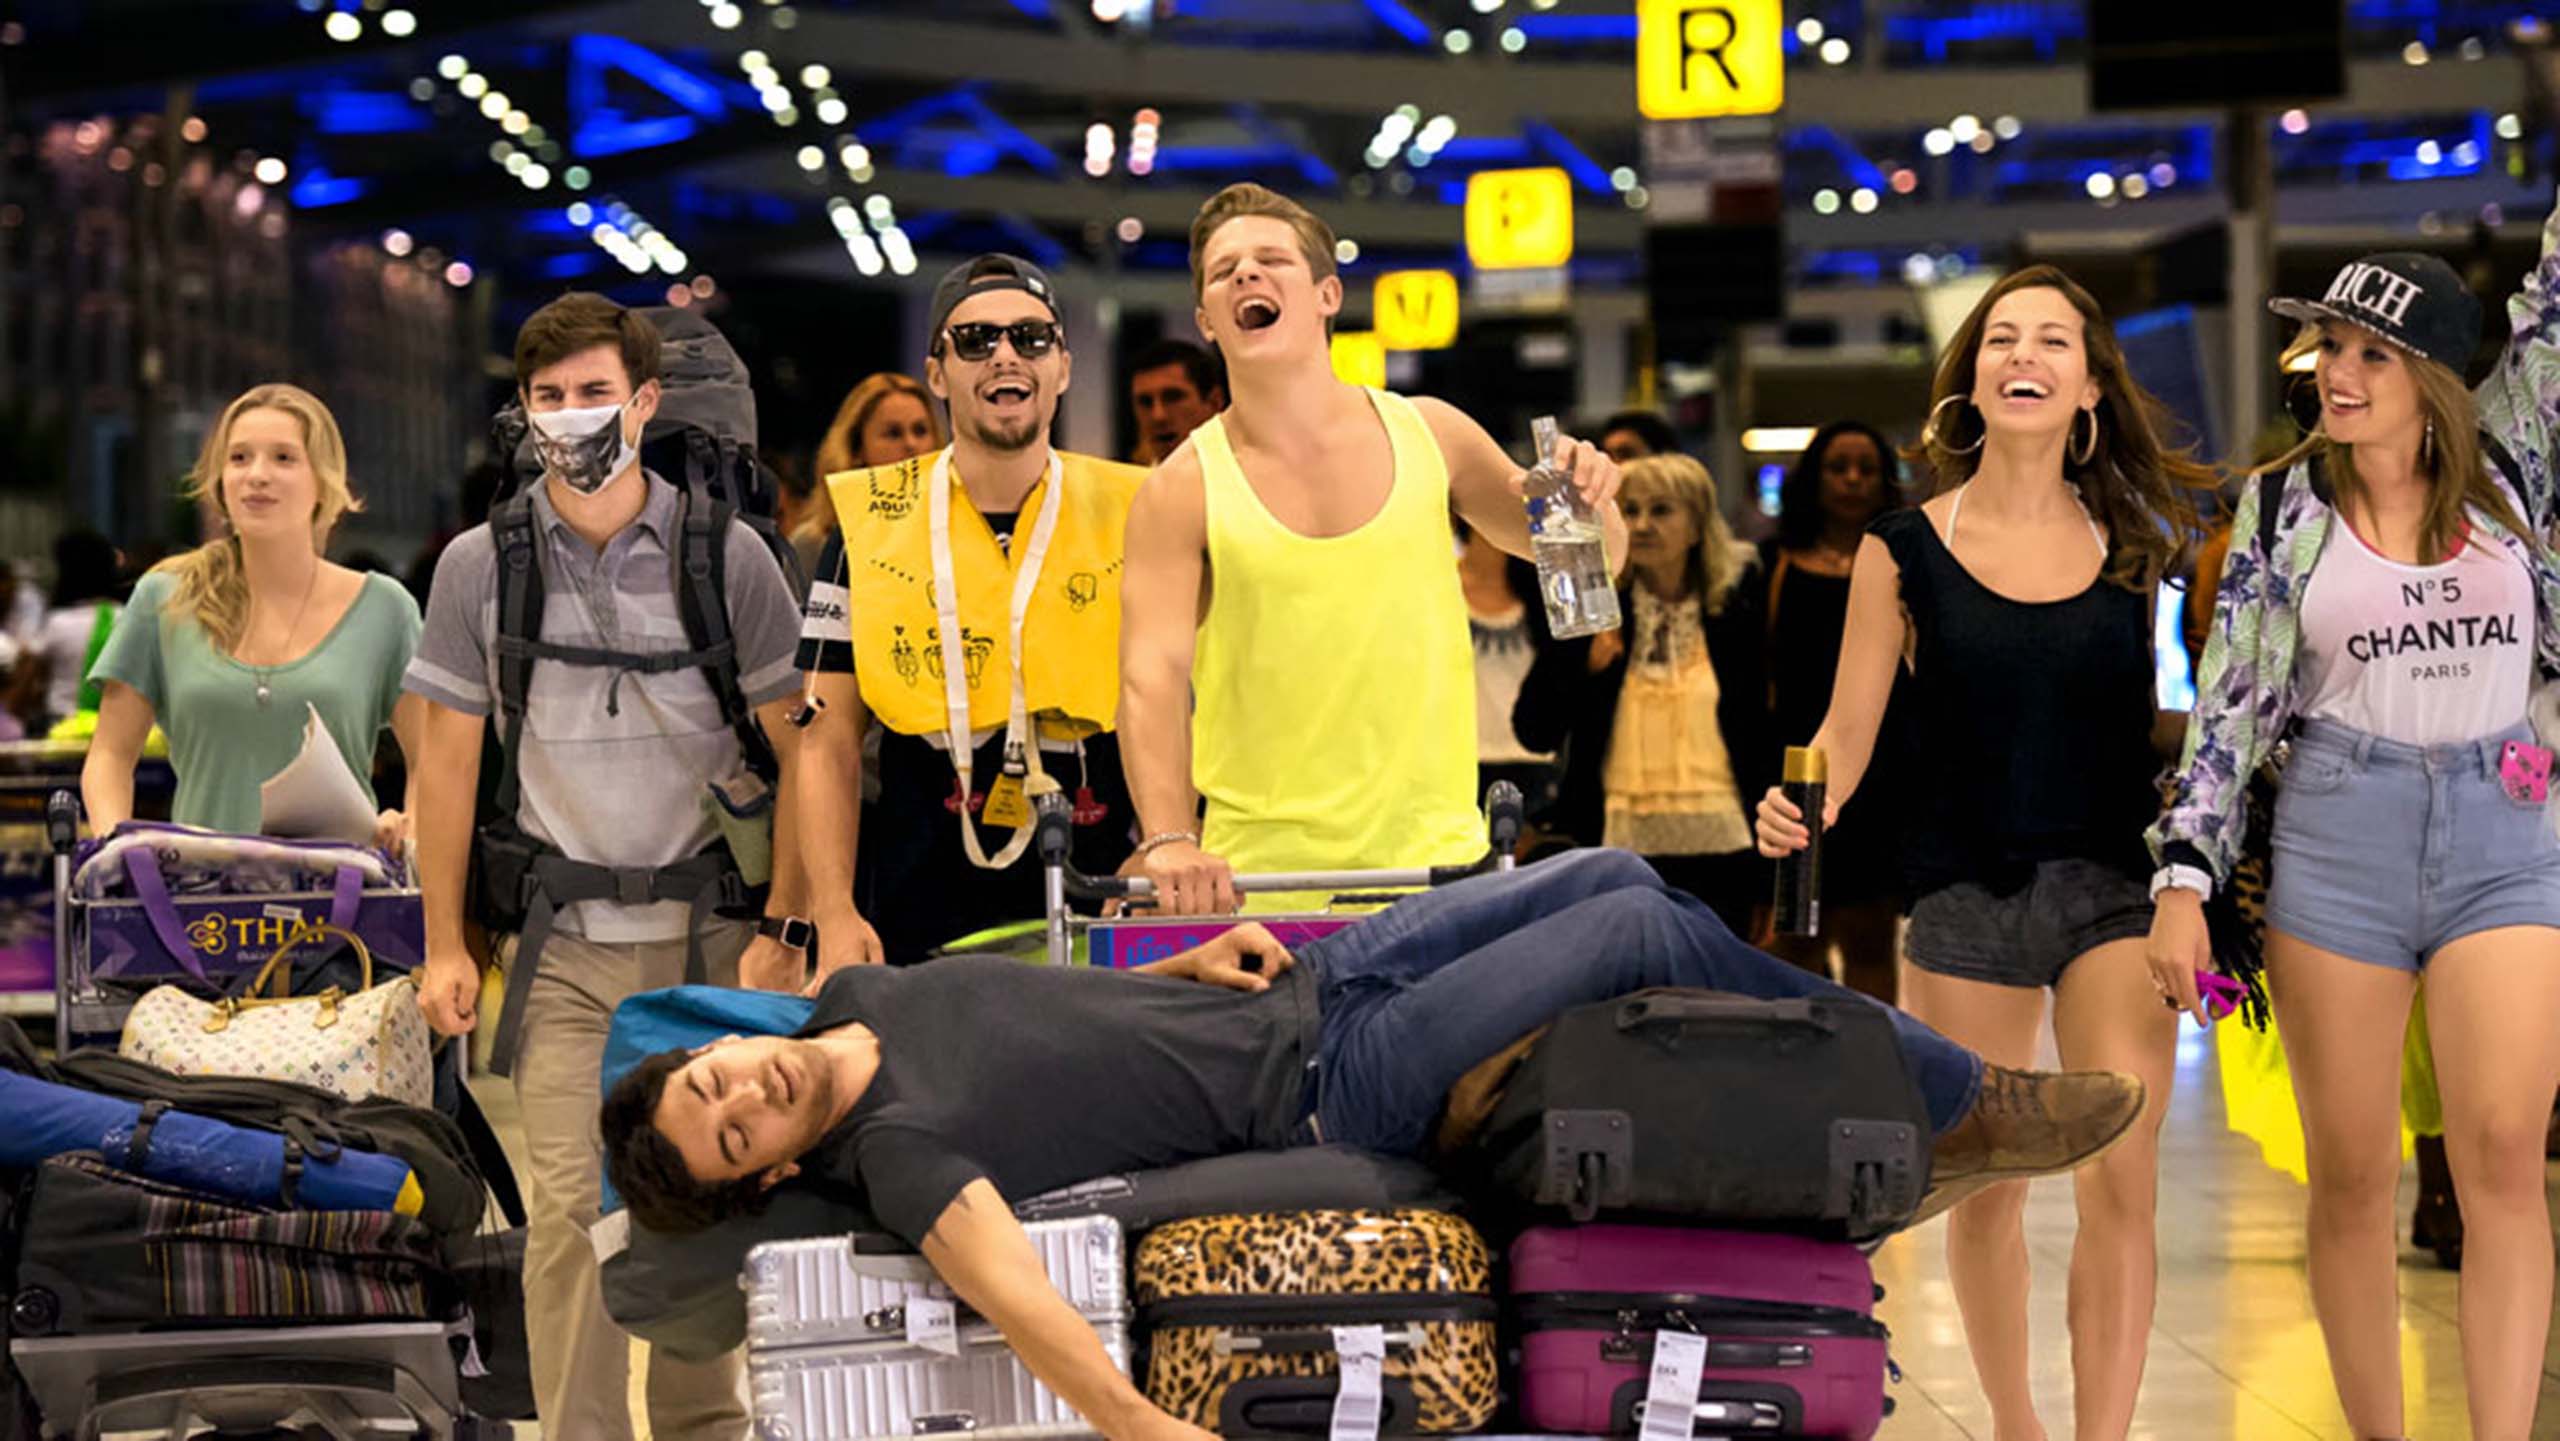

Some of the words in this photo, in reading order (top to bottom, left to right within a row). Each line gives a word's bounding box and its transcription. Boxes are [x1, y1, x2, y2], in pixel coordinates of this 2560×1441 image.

[1679, 8, 1740, 91] R
[2347, 614, 2518, 664] CHANTAL
[2411, 663, 2472, 681] PARIS
[231, 915, 325, 945] THAI
